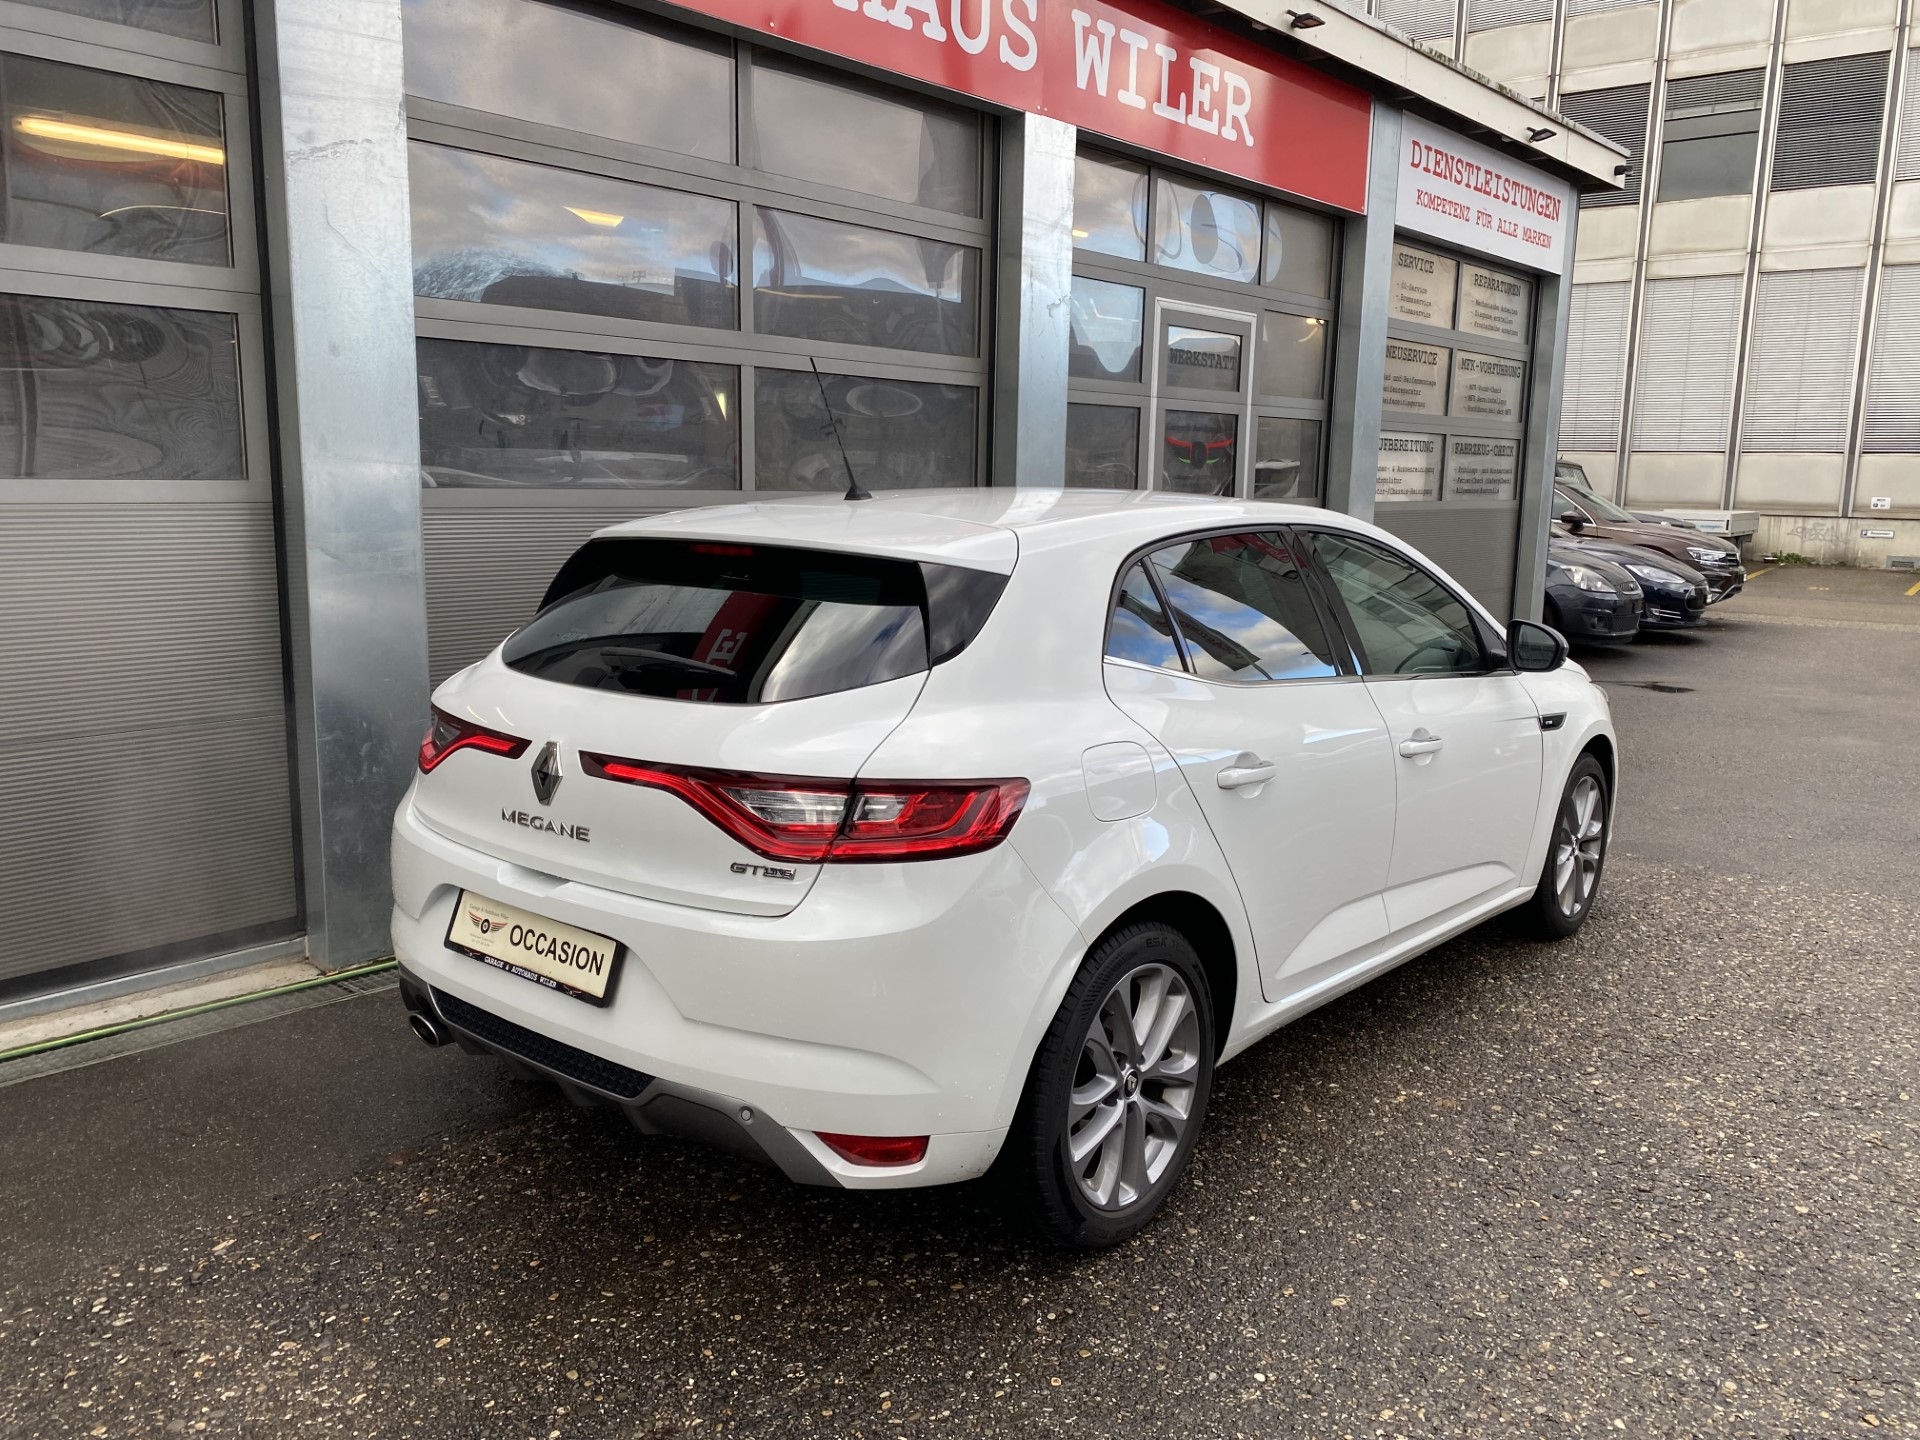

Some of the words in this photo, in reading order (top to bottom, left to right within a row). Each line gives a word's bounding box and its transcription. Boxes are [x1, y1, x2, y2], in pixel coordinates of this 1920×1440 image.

[832, 0, 1038, 72] US
[1072, 9, 1255, 147] WILER
[1410, 139, 1562, 222] DIENSTLEISTUNGEN
[1416, 188, 1470, 222] KOMPETENZ
[1475, 207, 1493, 230] FÜR
[1496, 218, 1518, 239] ALLE
[1522, 226, 1552, 249] MARKEN
[1398, 252, 1435, 274] SERVICE
[1473, 273, 1521, 297] REPARATUREN
[1168, 347, 1238, 371] WERKSTATT
[1454, 442, 1515, 457] FAHRZEUG-CHECK
[501, 807, 591, 843] MEGANE
[509, 924, 605, 976] OCCASION
[484, 955, 504, 969] GARAGE
[510, 965, 538, 981] AUTOHAUS
[540, 975, 557, 988] WILER
